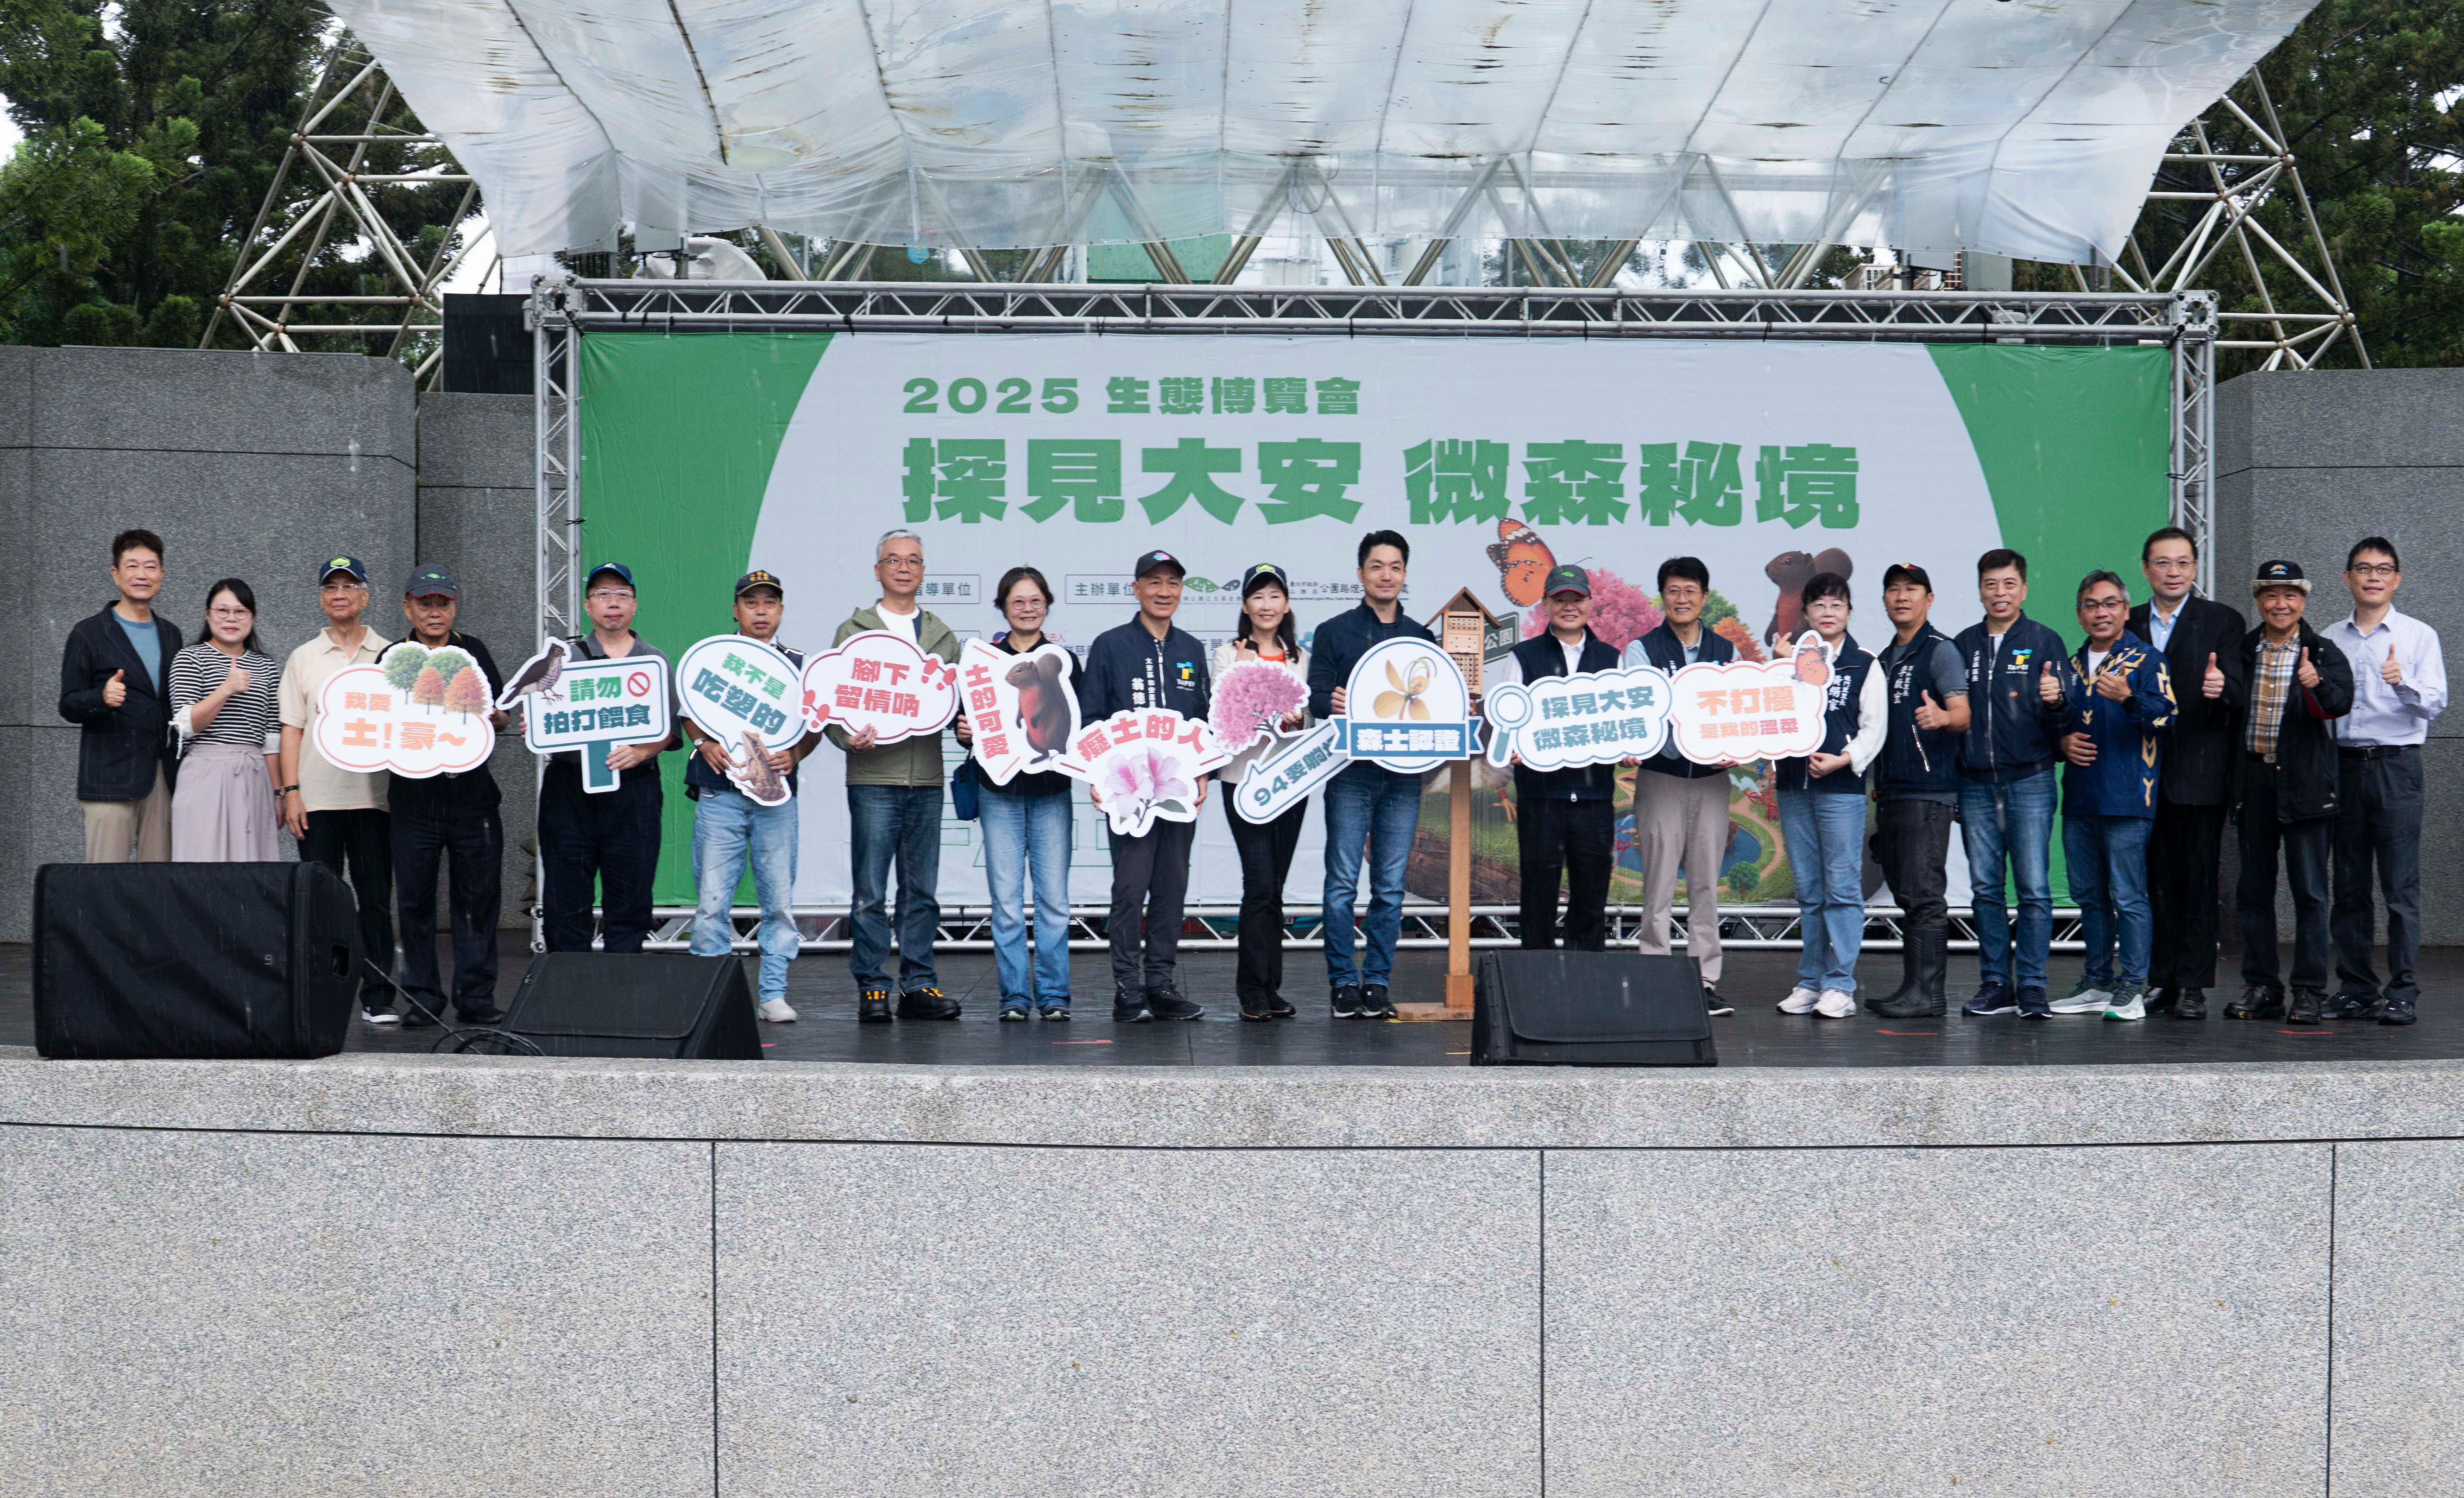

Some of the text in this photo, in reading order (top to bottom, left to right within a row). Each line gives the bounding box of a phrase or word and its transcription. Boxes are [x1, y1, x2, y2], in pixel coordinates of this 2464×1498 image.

[903, 377, 1361, 415] 2025 生態博覽會
[902, 437, 1859, 530] 探見大安 微森秘境
[1075, 582, 1134, 596] 主辦單位
[1484, 627, 1513, 651] 公園
[721, 652, 787, 701] 我不是
[850, 657, 910, 686] 腳下
[345, 691, 391, 712] 我愛
[570, 676, 622, 702] 請勿
[691, 667, 788, 735] 吃塑的
[1542, 686, 1655, 720] 探見大安
[1696, 685, 1796, 716] 不打擾
[544, 703, 651, 735] 拍打餵食
[1532, 717, 1647, 752] 微森秘境
[1700, 718, 1799, 740] 是我的溫柔
